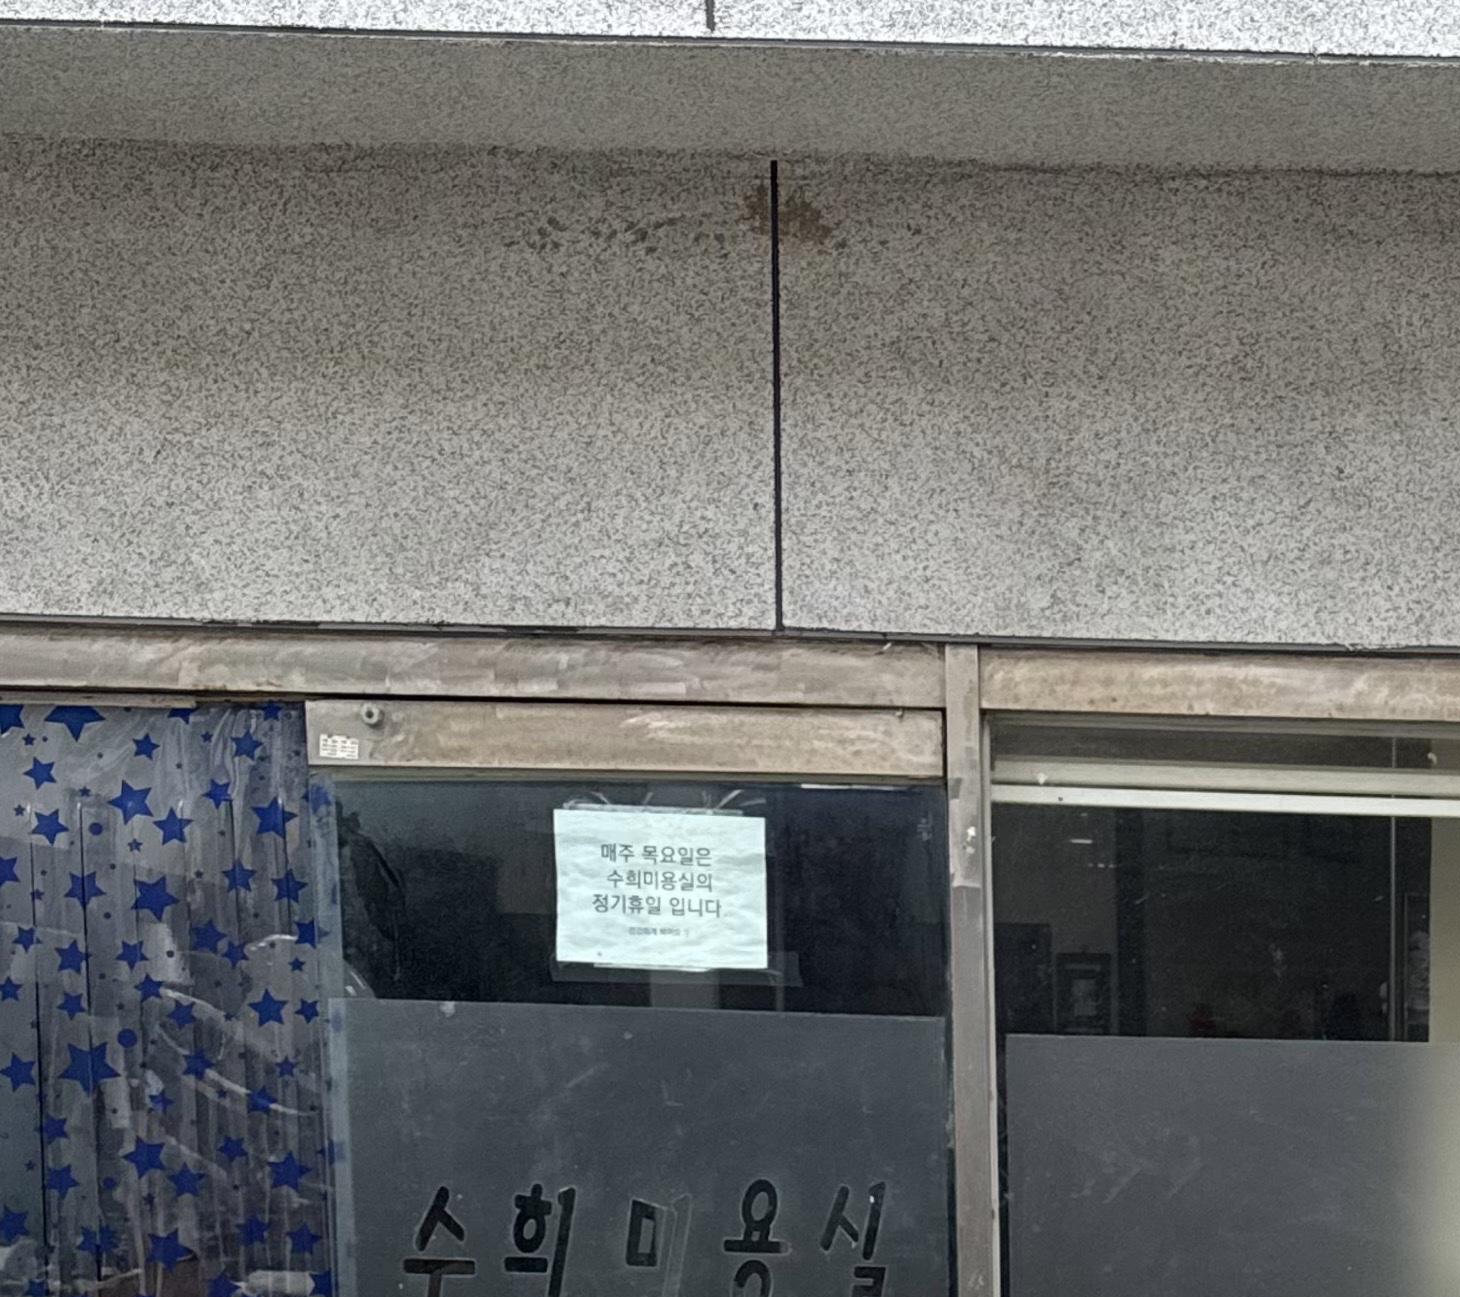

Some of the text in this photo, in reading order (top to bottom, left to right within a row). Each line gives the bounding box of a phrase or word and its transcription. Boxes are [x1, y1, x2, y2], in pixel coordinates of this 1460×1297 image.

[601, 843, 713, 868] 매주 목요일은
[606, 868, 714, 893] 수희미용실의
[592, 893, 722, 918] 정기휴일 입니다
